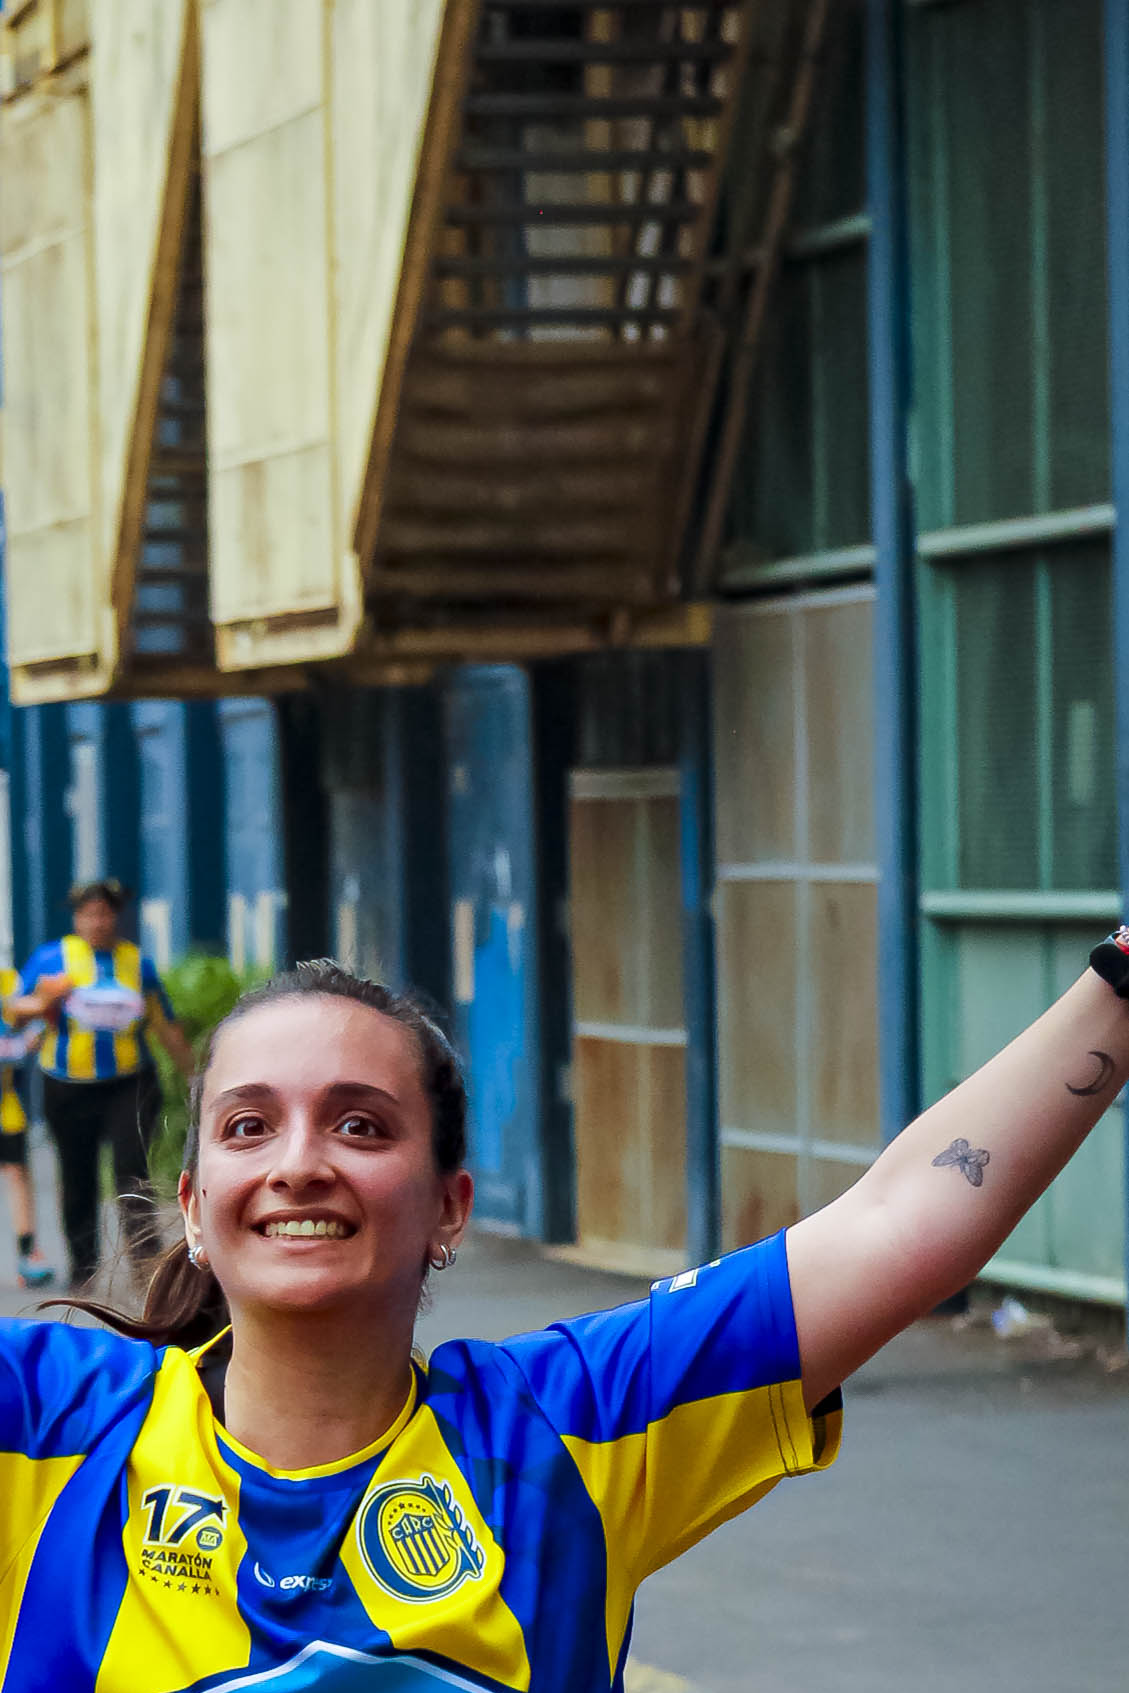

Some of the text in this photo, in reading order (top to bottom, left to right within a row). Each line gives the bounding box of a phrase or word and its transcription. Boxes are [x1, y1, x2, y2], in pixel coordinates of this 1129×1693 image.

[142, 1484, 230, 1547] 17
[392, 1515, 433, 1539] CARC
[141, 1548, 213, 1570] MARATÓN
[141, 1559, 212, 1581] CANALLA
